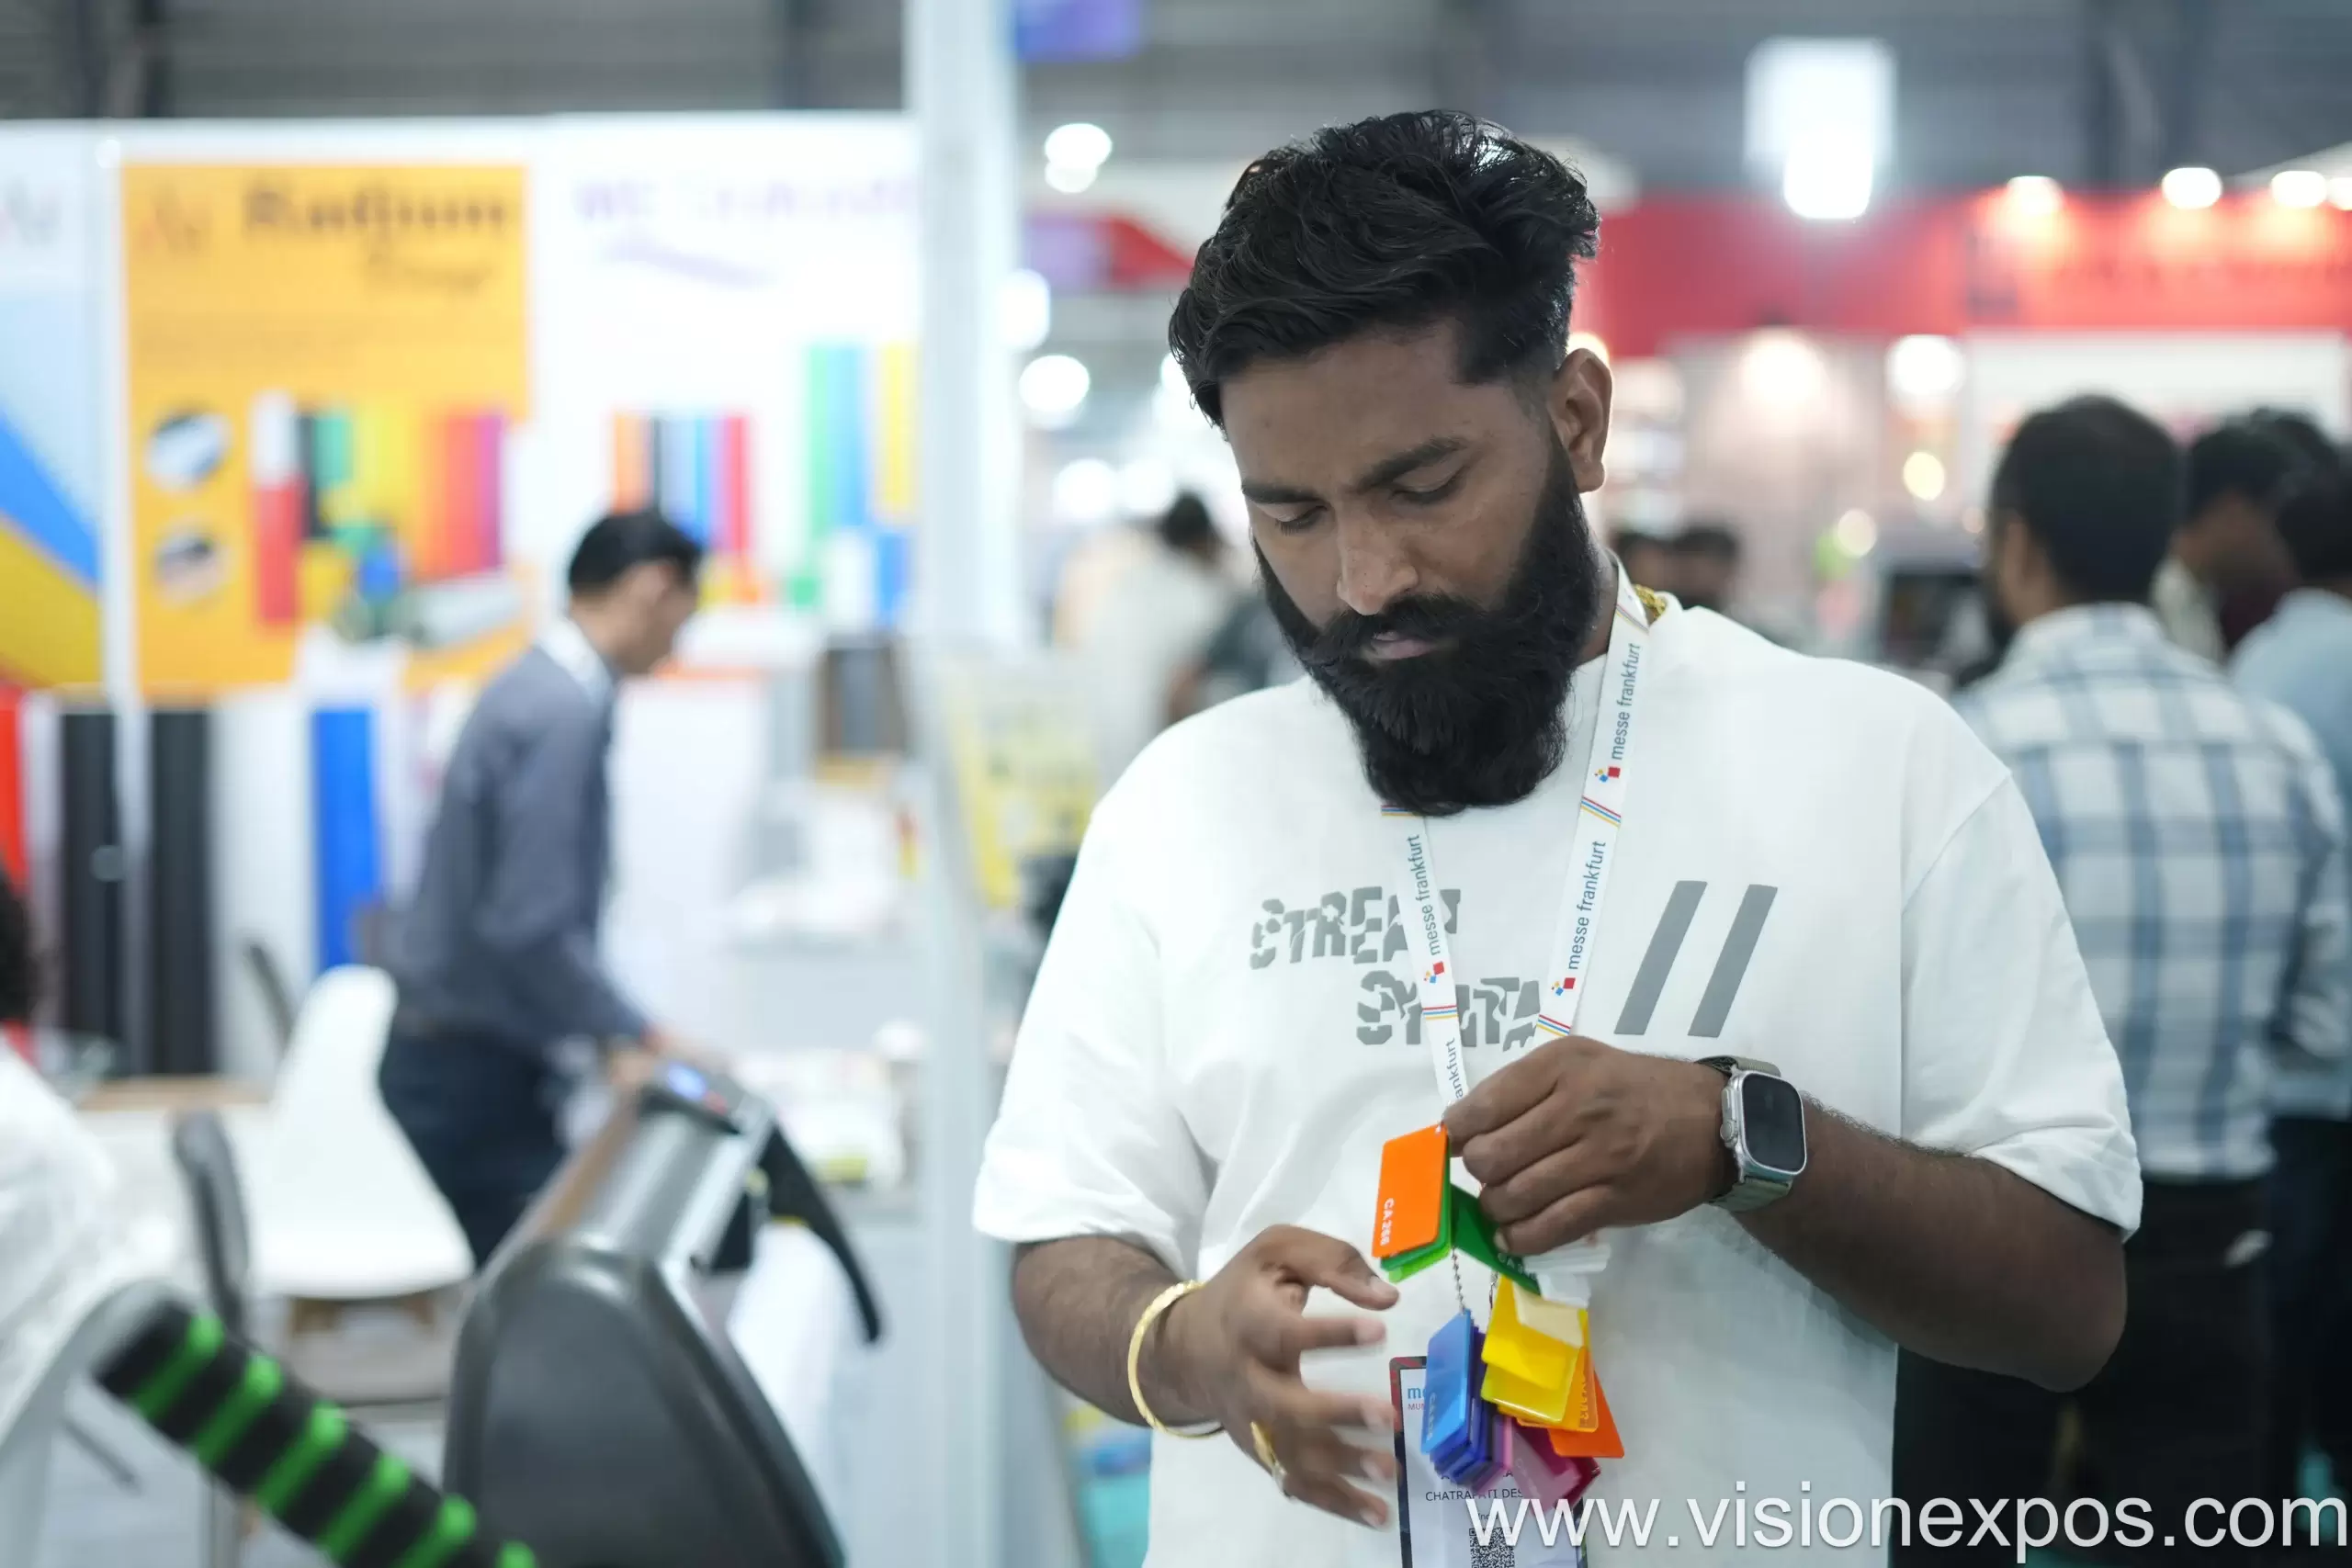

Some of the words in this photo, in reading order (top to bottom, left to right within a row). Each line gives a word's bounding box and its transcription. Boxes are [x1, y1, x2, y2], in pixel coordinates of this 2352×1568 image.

[1616, 642, 1641, 706] frankfurt
[1611, 711, 1631, 761] messe
[1407, 834, 1430, 901] frankfurt
[1577, 840, 1606, 911] frankfurt
[1421, 904, 1442, 956] messe
[1568, 917, 1589, 970] messe
[1445, 1036, 1464, 1099] ankfurt
